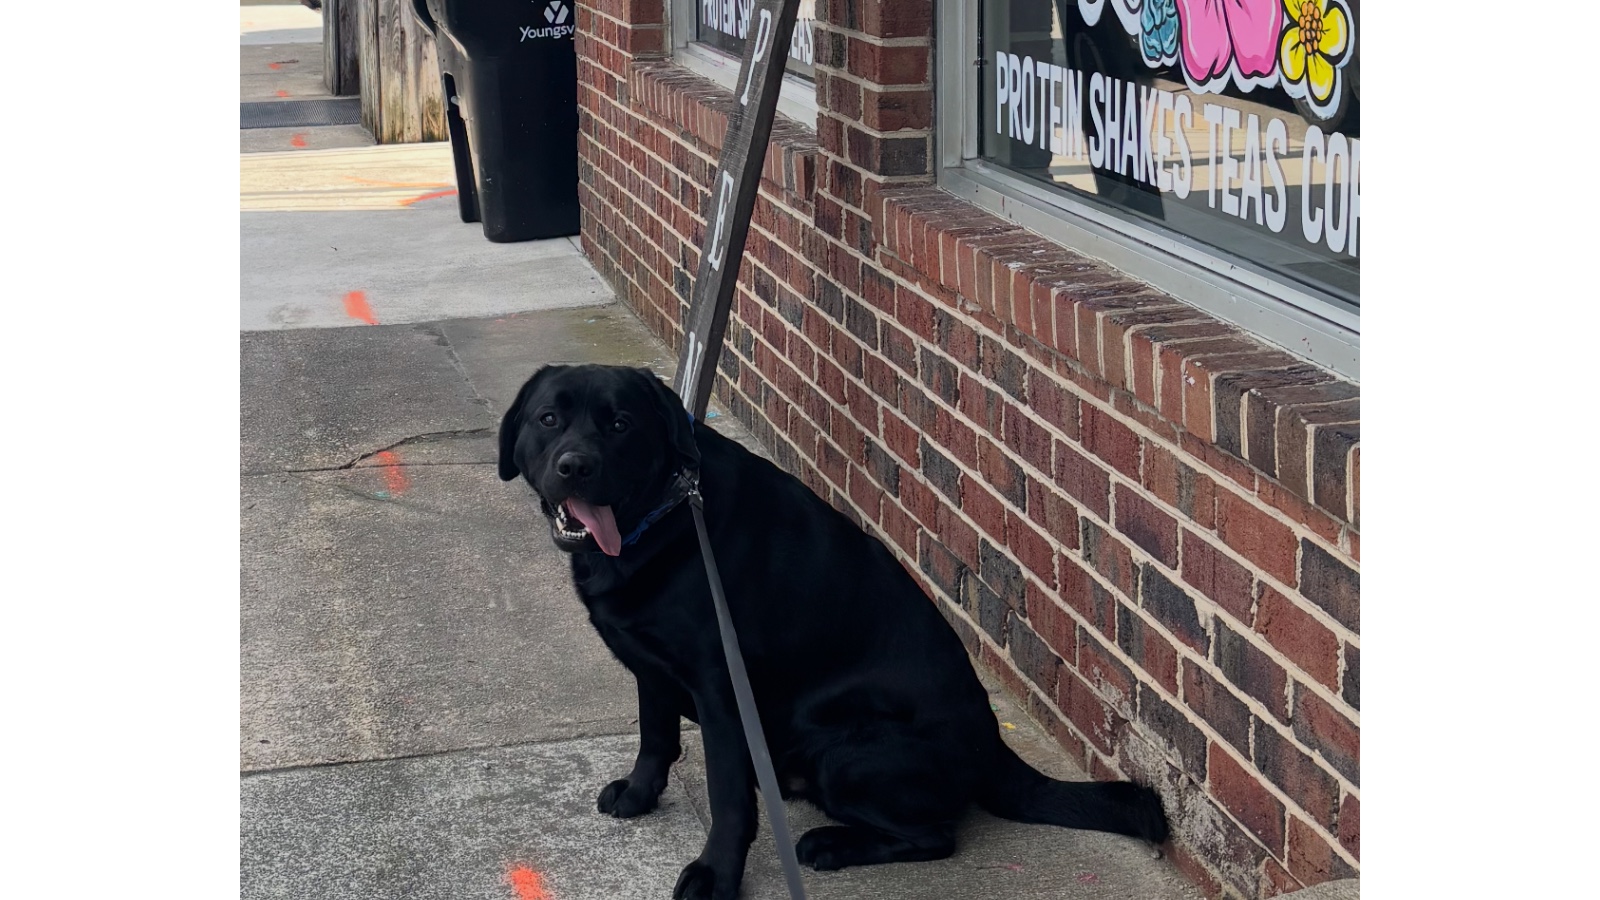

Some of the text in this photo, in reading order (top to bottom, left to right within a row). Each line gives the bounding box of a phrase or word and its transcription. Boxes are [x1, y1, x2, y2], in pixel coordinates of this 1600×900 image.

[788, 8, 813, 65] EAS
[996, 51, 1083, 160] PROTEIN
[1089, 72, 1195, 199] SHAKES
[1204, 104, 1287, 233] TEAS
